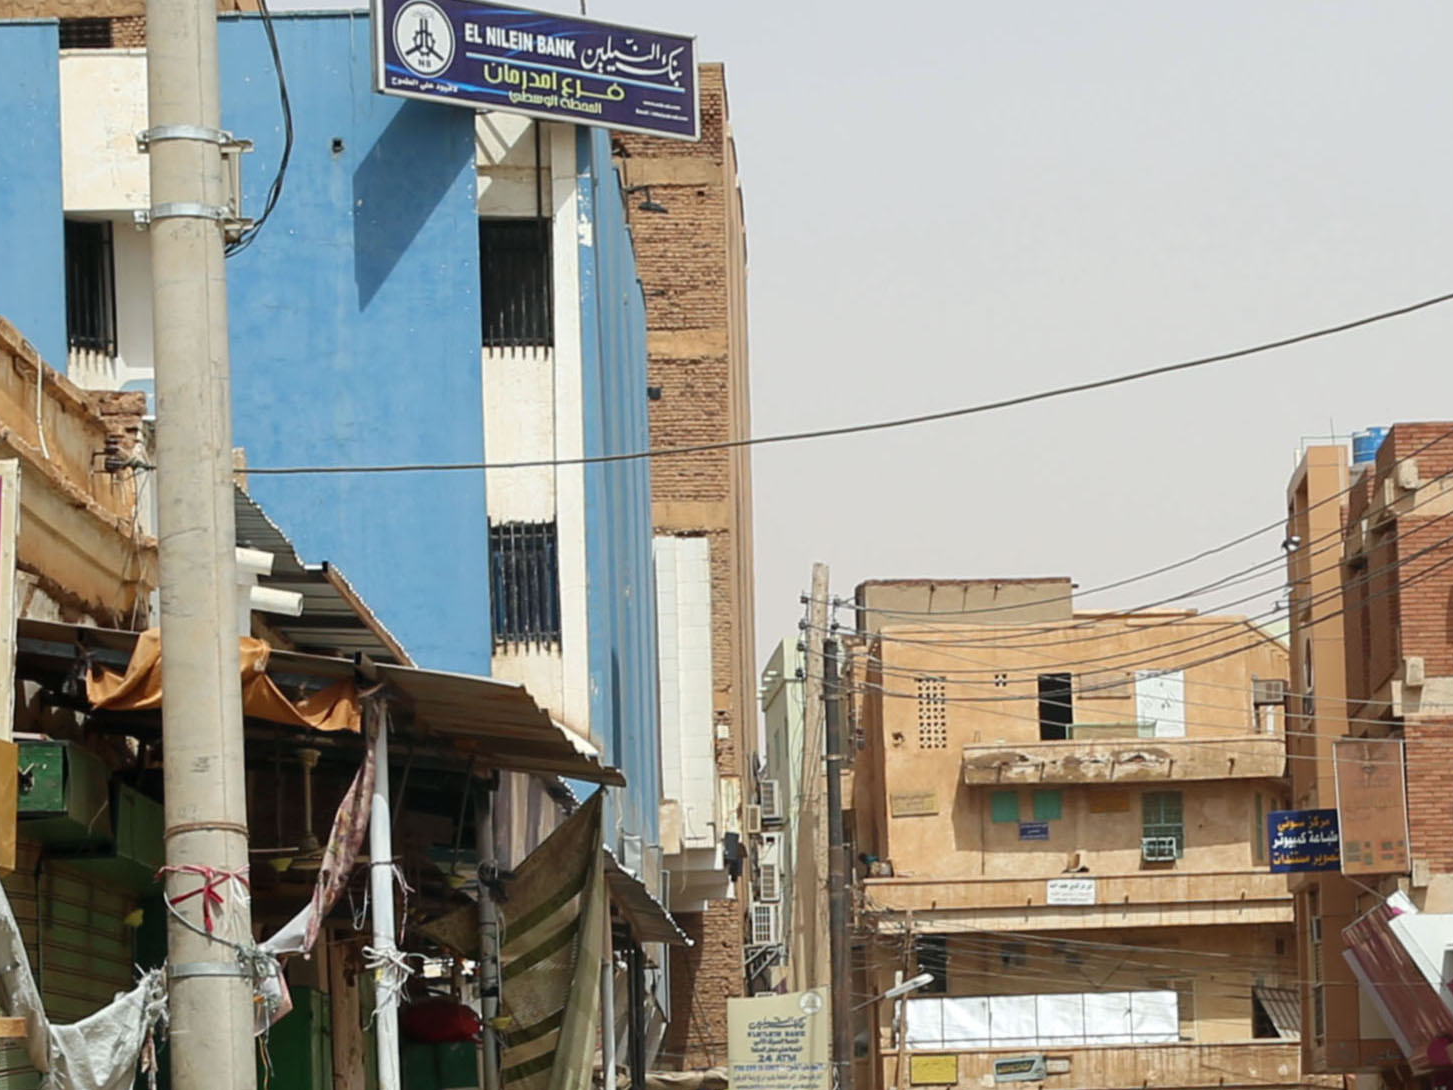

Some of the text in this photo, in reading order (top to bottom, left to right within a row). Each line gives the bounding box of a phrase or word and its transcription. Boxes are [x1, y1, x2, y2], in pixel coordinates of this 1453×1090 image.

[465, 22, 577, 60] EL NILEIN BANK
[561, 77, 625, 101] فرع
